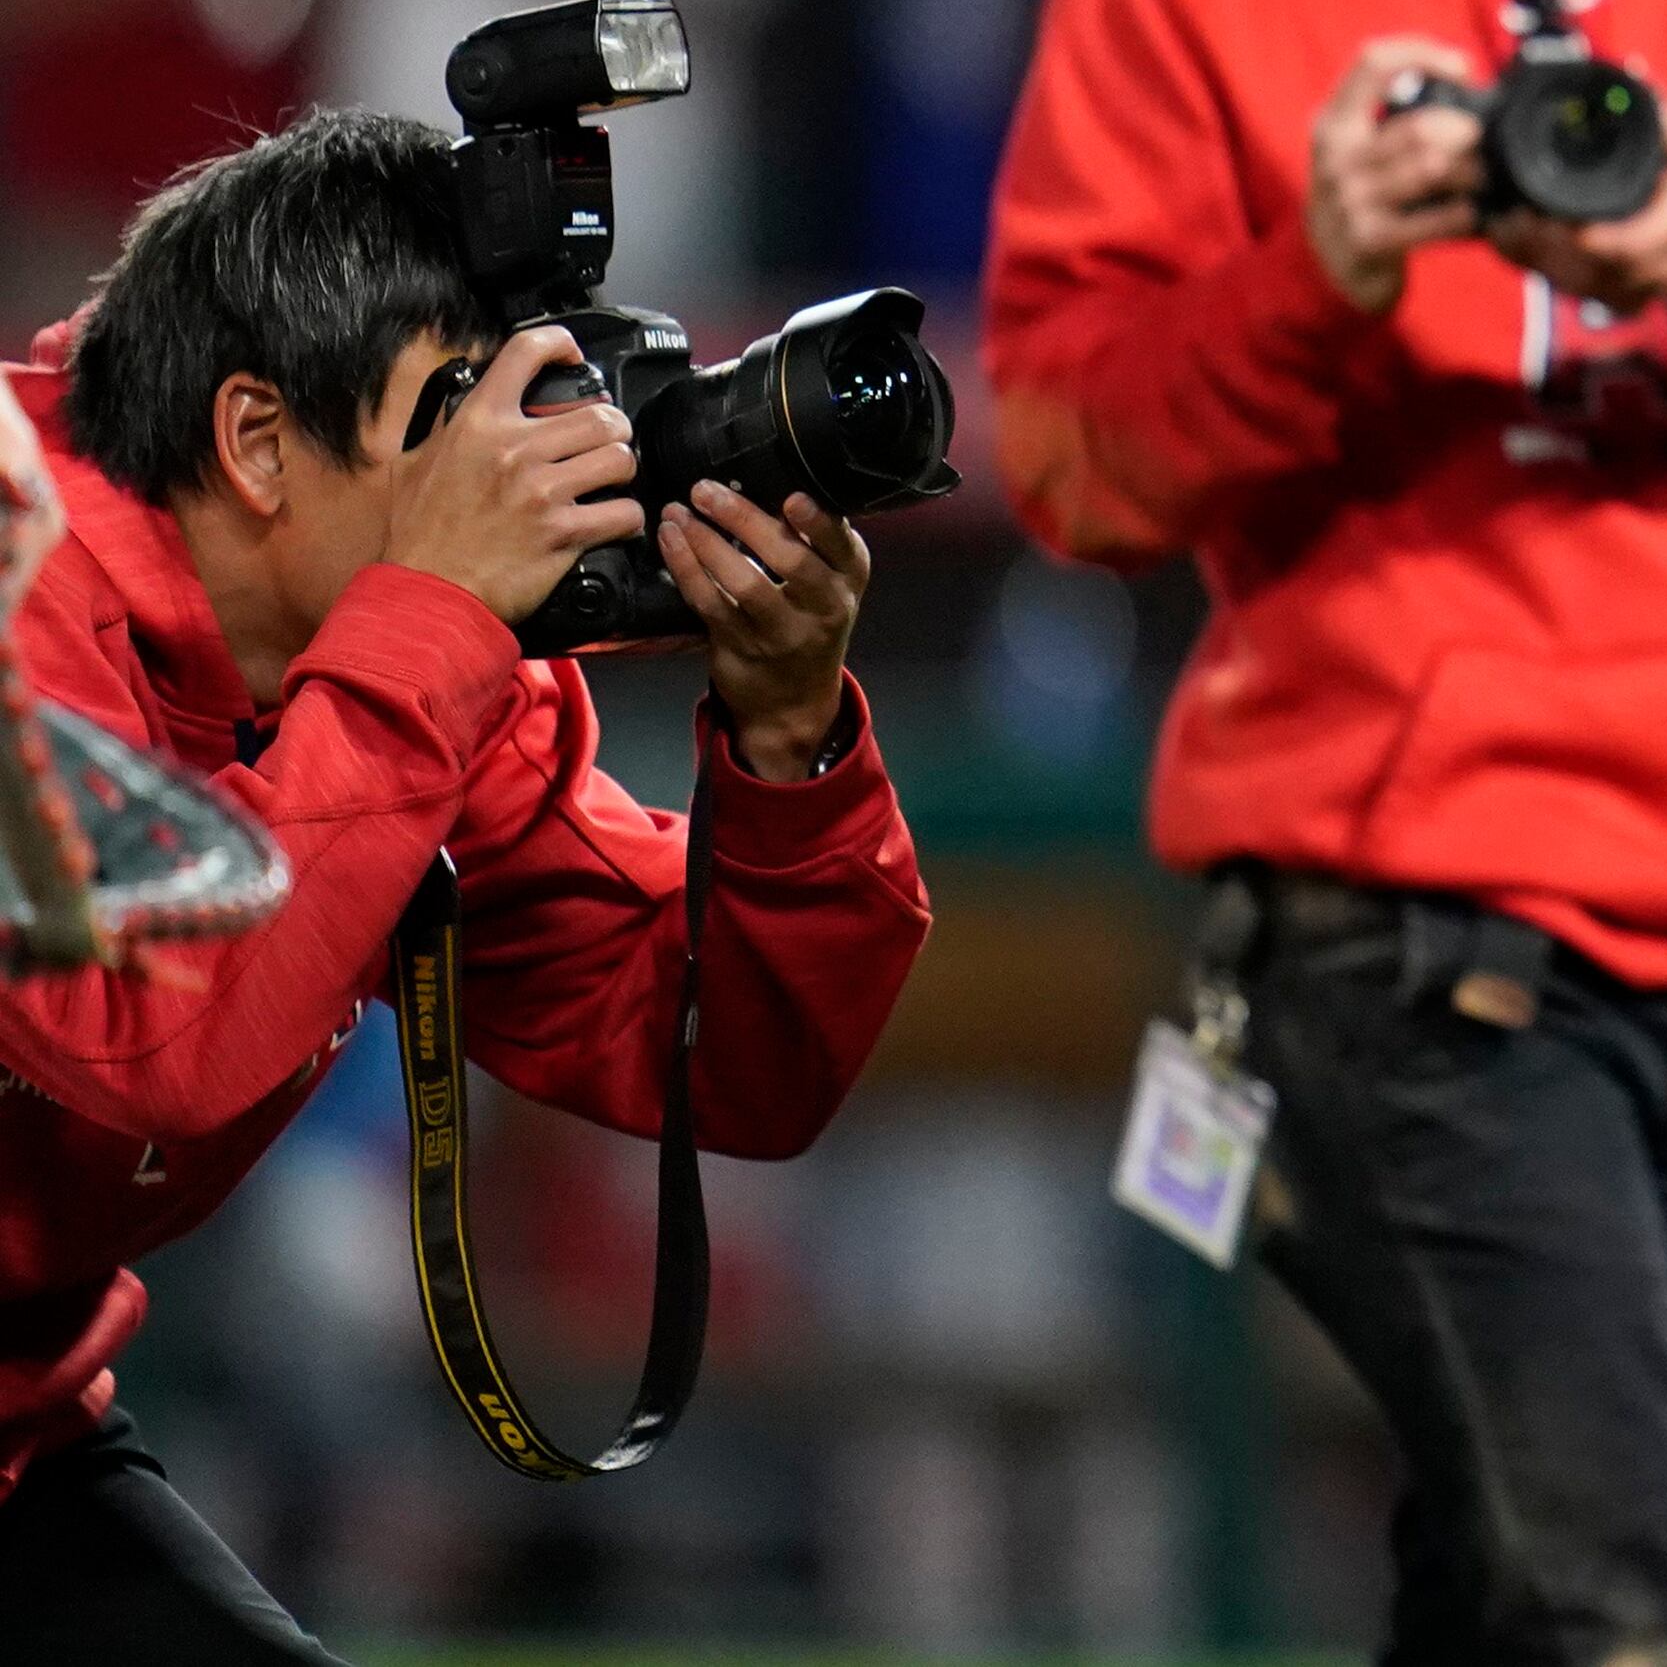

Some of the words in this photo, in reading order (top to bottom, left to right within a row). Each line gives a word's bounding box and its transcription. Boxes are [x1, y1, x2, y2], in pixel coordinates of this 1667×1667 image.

[644, 331, 688, 350] Nikon
[413, 955, 438, 1061] Nikon
[419, 1075, 453, 1168] D5
